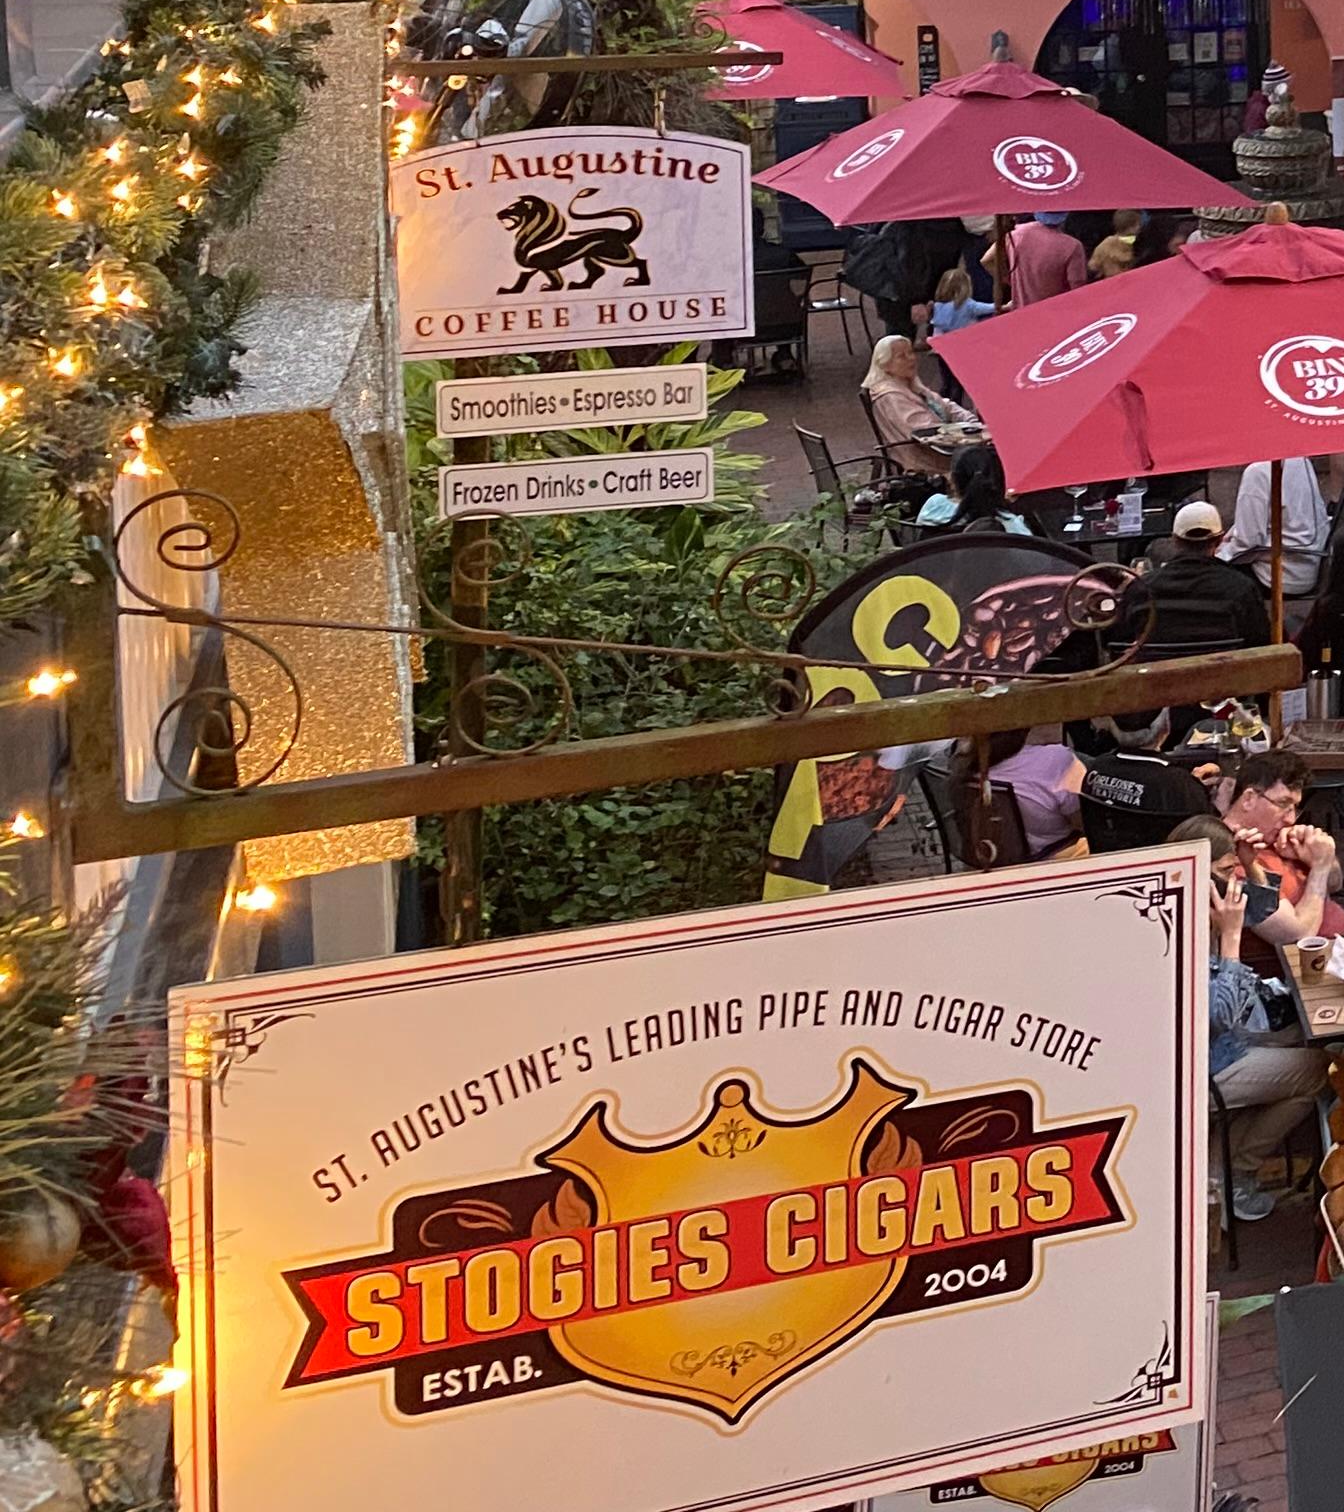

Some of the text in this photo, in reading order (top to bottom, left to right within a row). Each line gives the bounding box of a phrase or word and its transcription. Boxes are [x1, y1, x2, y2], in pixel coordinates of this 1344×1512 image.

[415, 146, 721, 199] St. Augustine
[1014, 152, 1055, 165] BIN
[1023, 164, 1054, 179] 39
[415, 296, 727, 338] COFFEE HOUSE
[450, 382, 694, 422] Smoothies Espresso Bar
[452, 467, 703, 506] Frozen Drinks Craft Beer
[312, 989, 1102, 1204] ST. AUGUSTINE'S LEADING PIPE AND CIGAR STORE
[345, 1143, 1076, 1358] STOGIES CIGARS
[923, 1258, 1009, 1299] 2004
[420, 1355, 545, 1403] ESTAB.
[1103, 1460, 1136, 1474] 2004
[938, 1485, 978, 1500] ESTAB.
